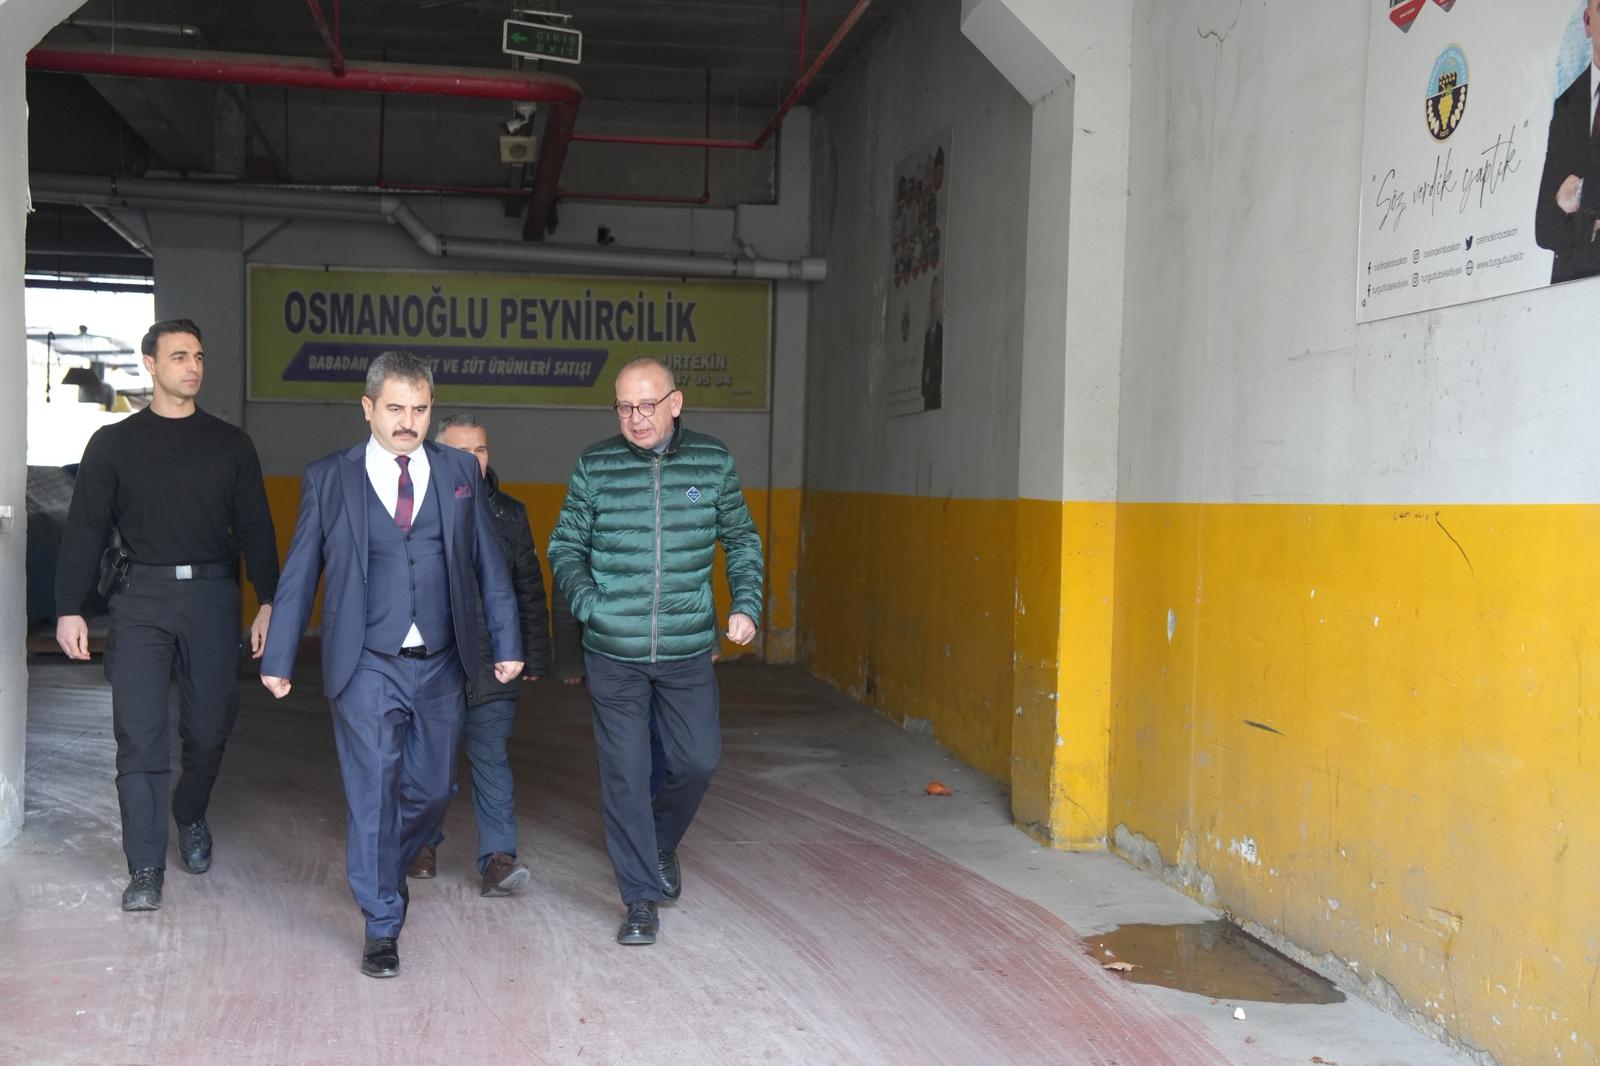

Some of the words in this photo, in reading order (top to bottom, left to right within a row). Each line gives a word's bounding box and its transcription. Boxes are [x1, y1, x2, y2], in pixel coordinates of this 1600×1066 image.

[536, 43, 577, 57] EXIT
[1413, 147, 1457, 216] verdik
[284, 285, 488, 339] OSMANOĞLU
[499, 289, 697, 342] PEYNİRCİLİK
[308, 355, 369, 371] BABADAN
[443, 358, 460, 374] VE
[462, 356, 486, 374] SÜT
[488, 356, 551, 376] ÜRÜNLERİ
[553, 361, 593, 380] SATIŞI
